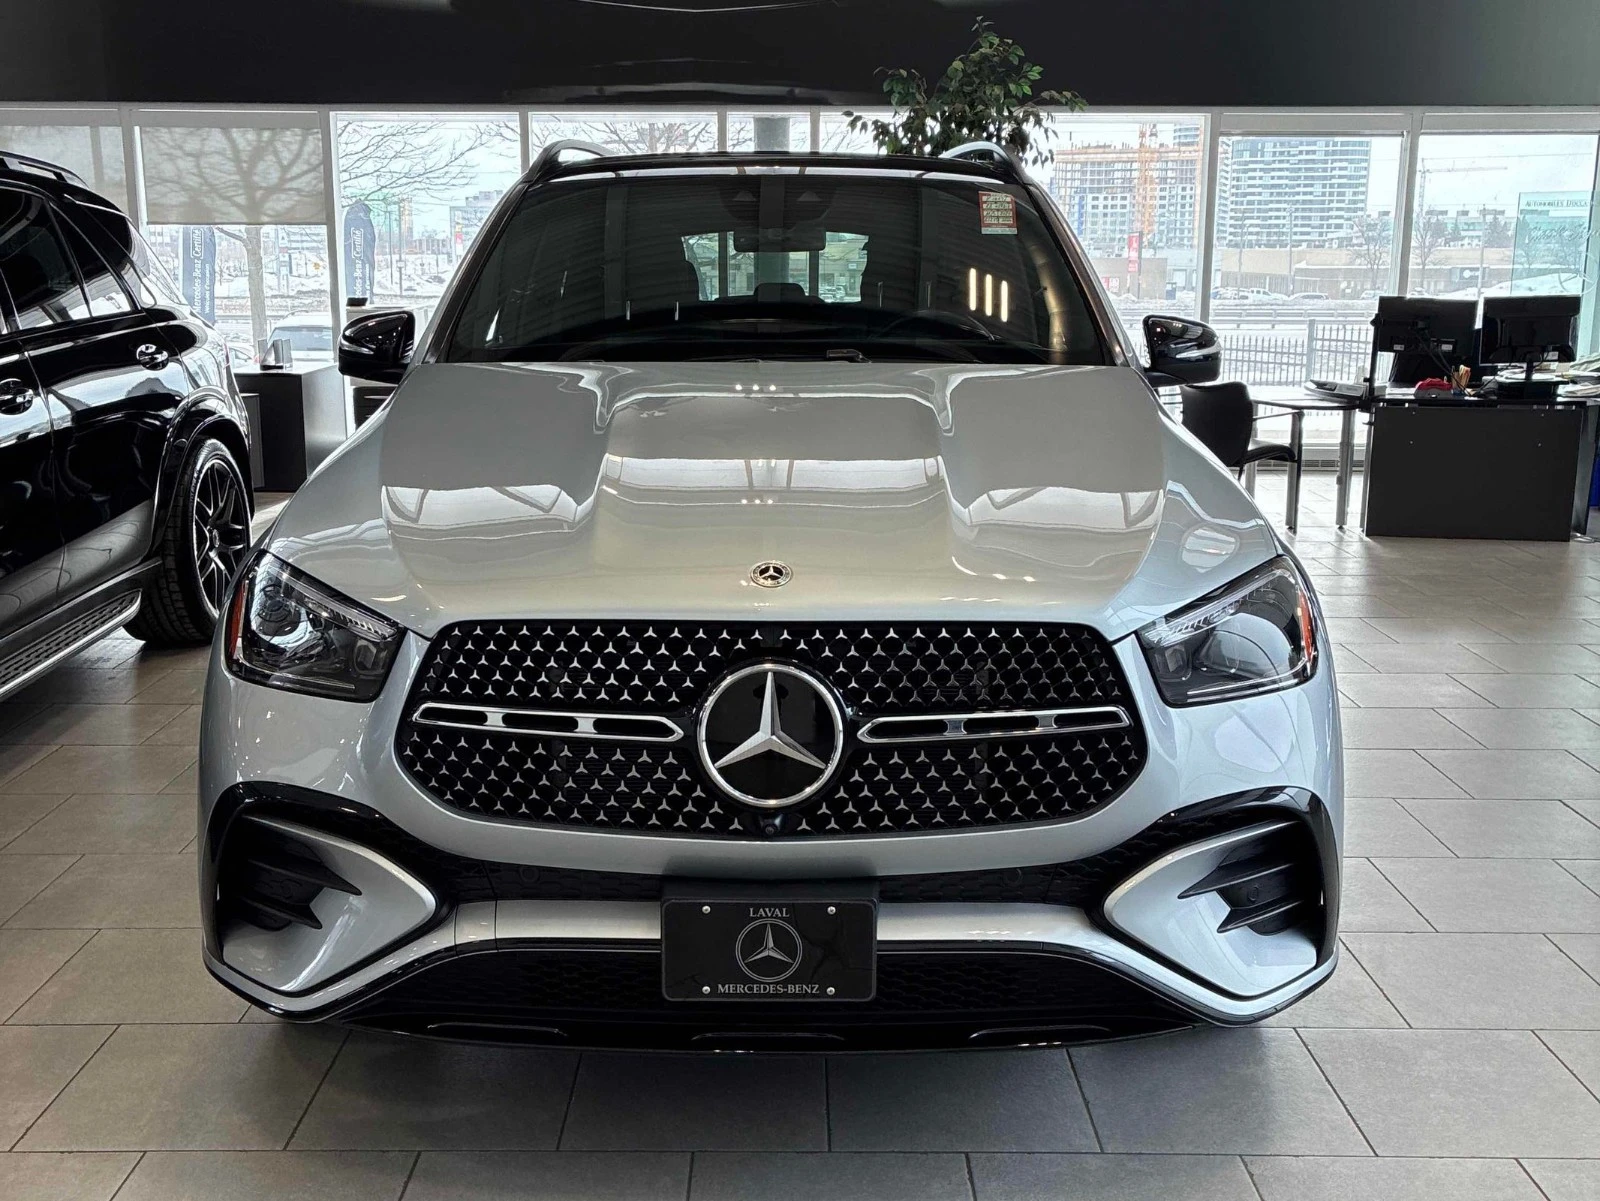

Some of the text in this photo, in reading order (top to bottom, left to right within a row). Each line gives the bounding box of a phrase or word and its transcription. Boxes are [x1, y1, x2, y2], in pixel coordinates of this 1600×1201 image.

[354, 230, 362, 257] Certifié
[193, 229, 202, 313] Mercedes-Benz Certifié
[749, 907, 790, 918] LAVAL
[717, 984, 820, 994] MERCEDES-BENZ
